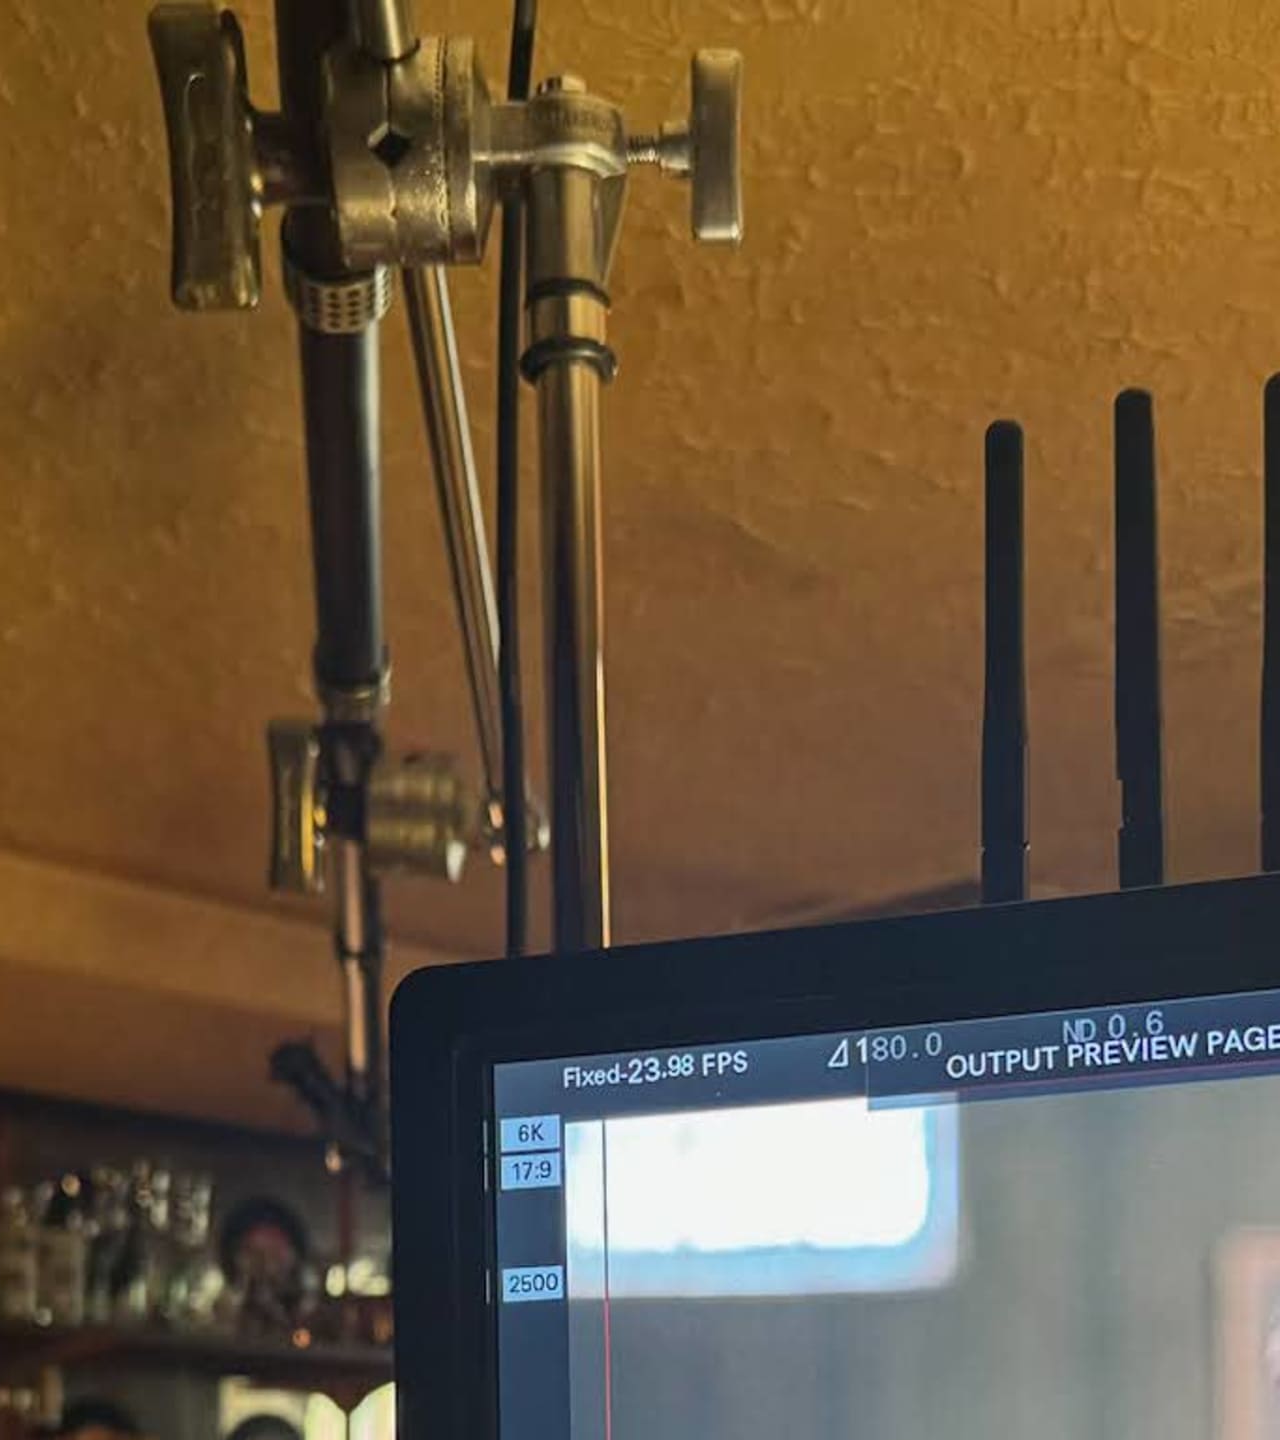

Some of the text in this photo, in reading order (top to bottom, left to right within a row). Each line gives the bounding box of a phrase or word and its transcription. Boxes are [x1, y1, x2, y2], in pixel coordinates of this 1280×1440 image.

[1062, 1010, 1164, 1043] ND 0.6
[945, 1044, 1060, 1079] OUTPUT
[1066, 1031, 1199, 1070] PREVIEW
[562, 1050, 749, 1089] Fixed-23.98 FPS
[517, 1121, 545, 1143] 6K
[511, 1160, 553, 1181] 17:9
[508, 1272, 559, 1294] 2500
